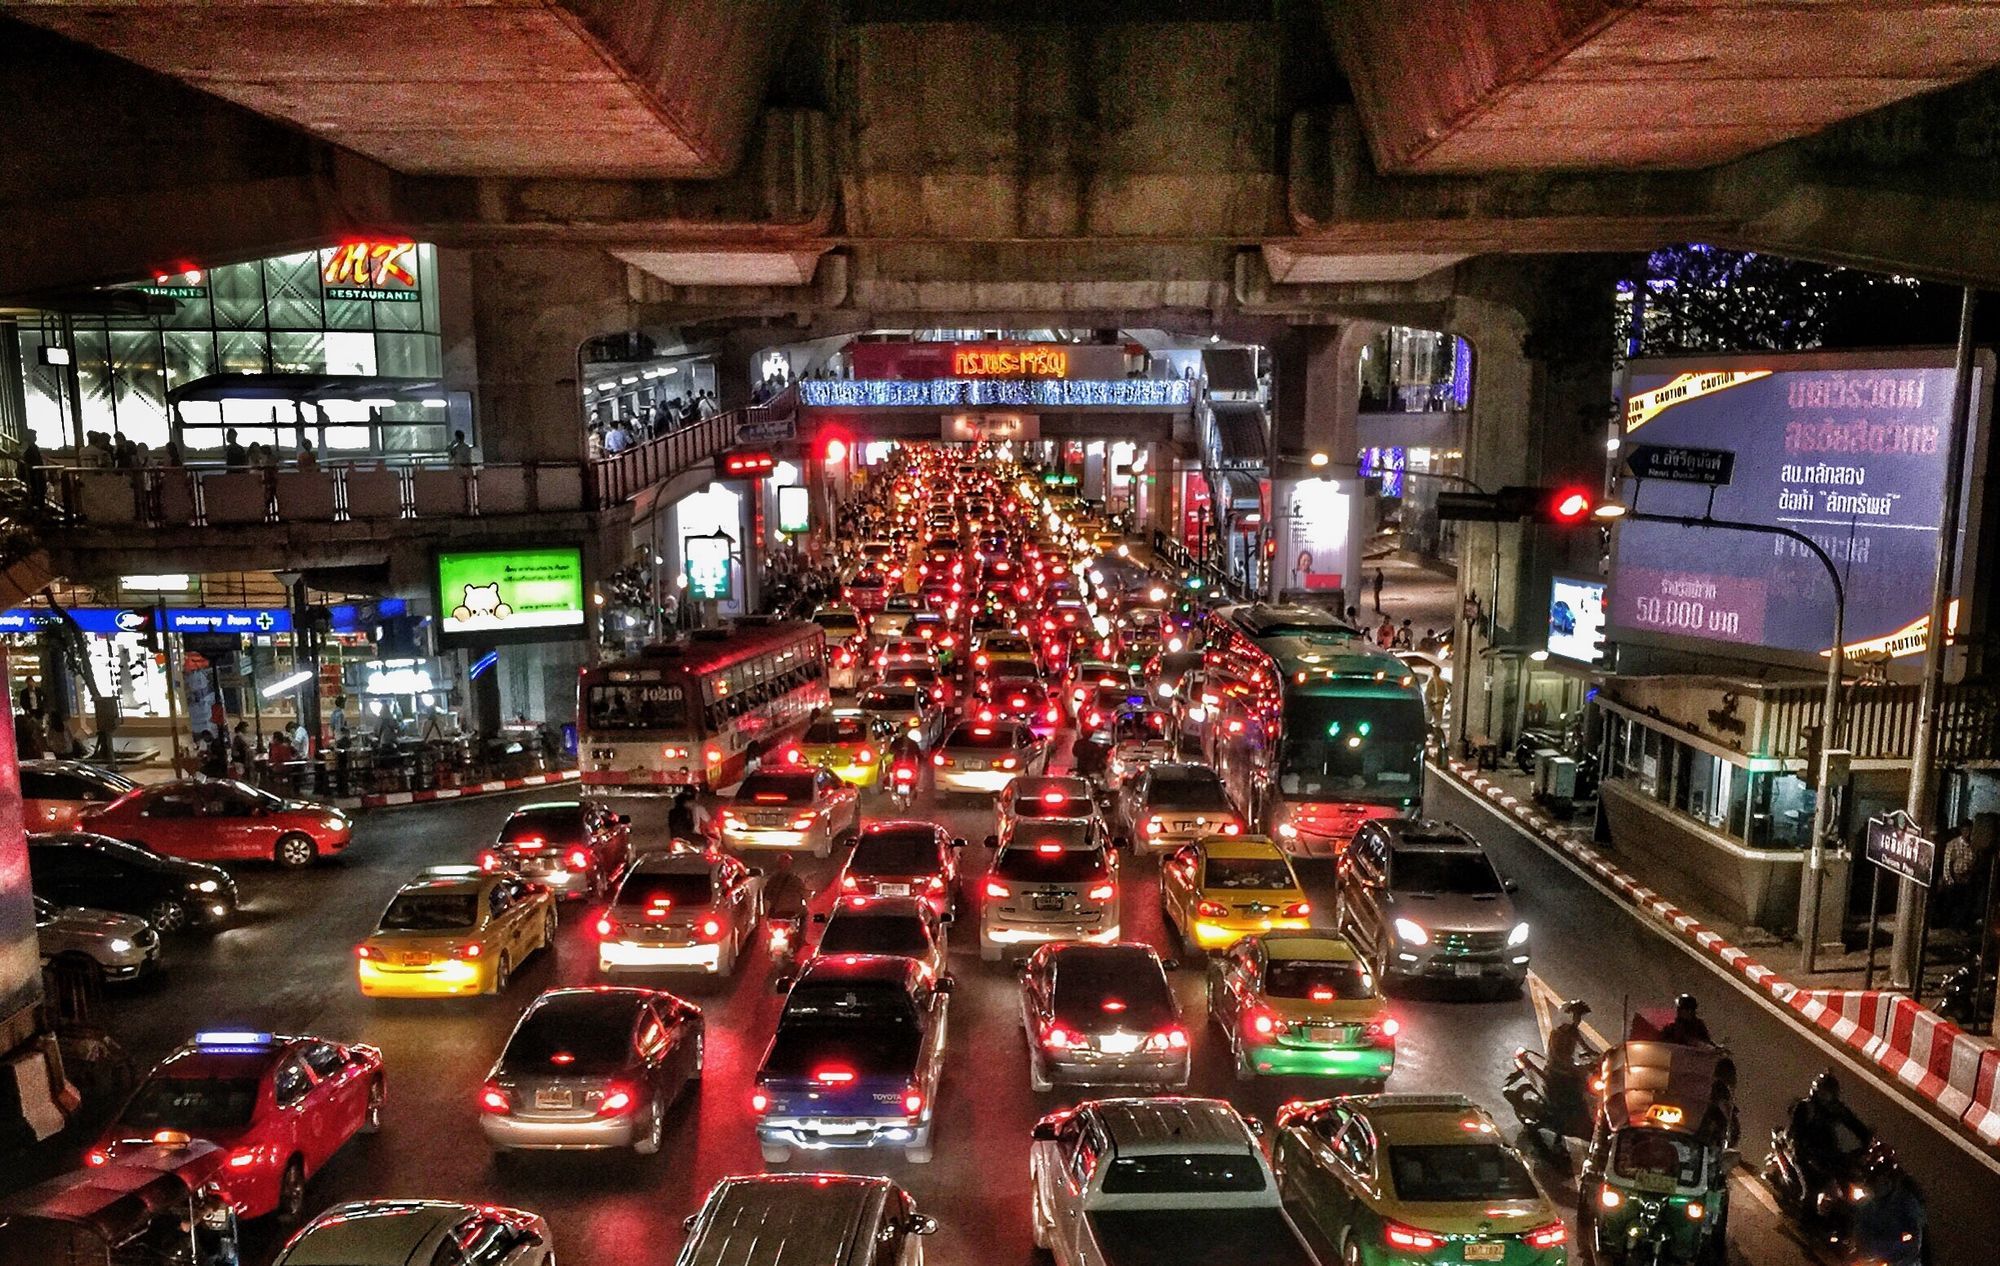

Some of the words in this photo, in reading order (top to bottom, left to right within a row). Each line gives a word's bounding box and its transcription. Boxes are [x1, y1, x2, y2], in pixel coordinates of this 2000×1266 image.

[323, 241, 414, 286] MK
[329, 289, 417, 300] RESTAURANTS
[1654, 384, 1688, 404] CAUTION
[1700, 371, 1736, 391] CAUTION
[872, 1093, 901, 1101] TOYOTA
